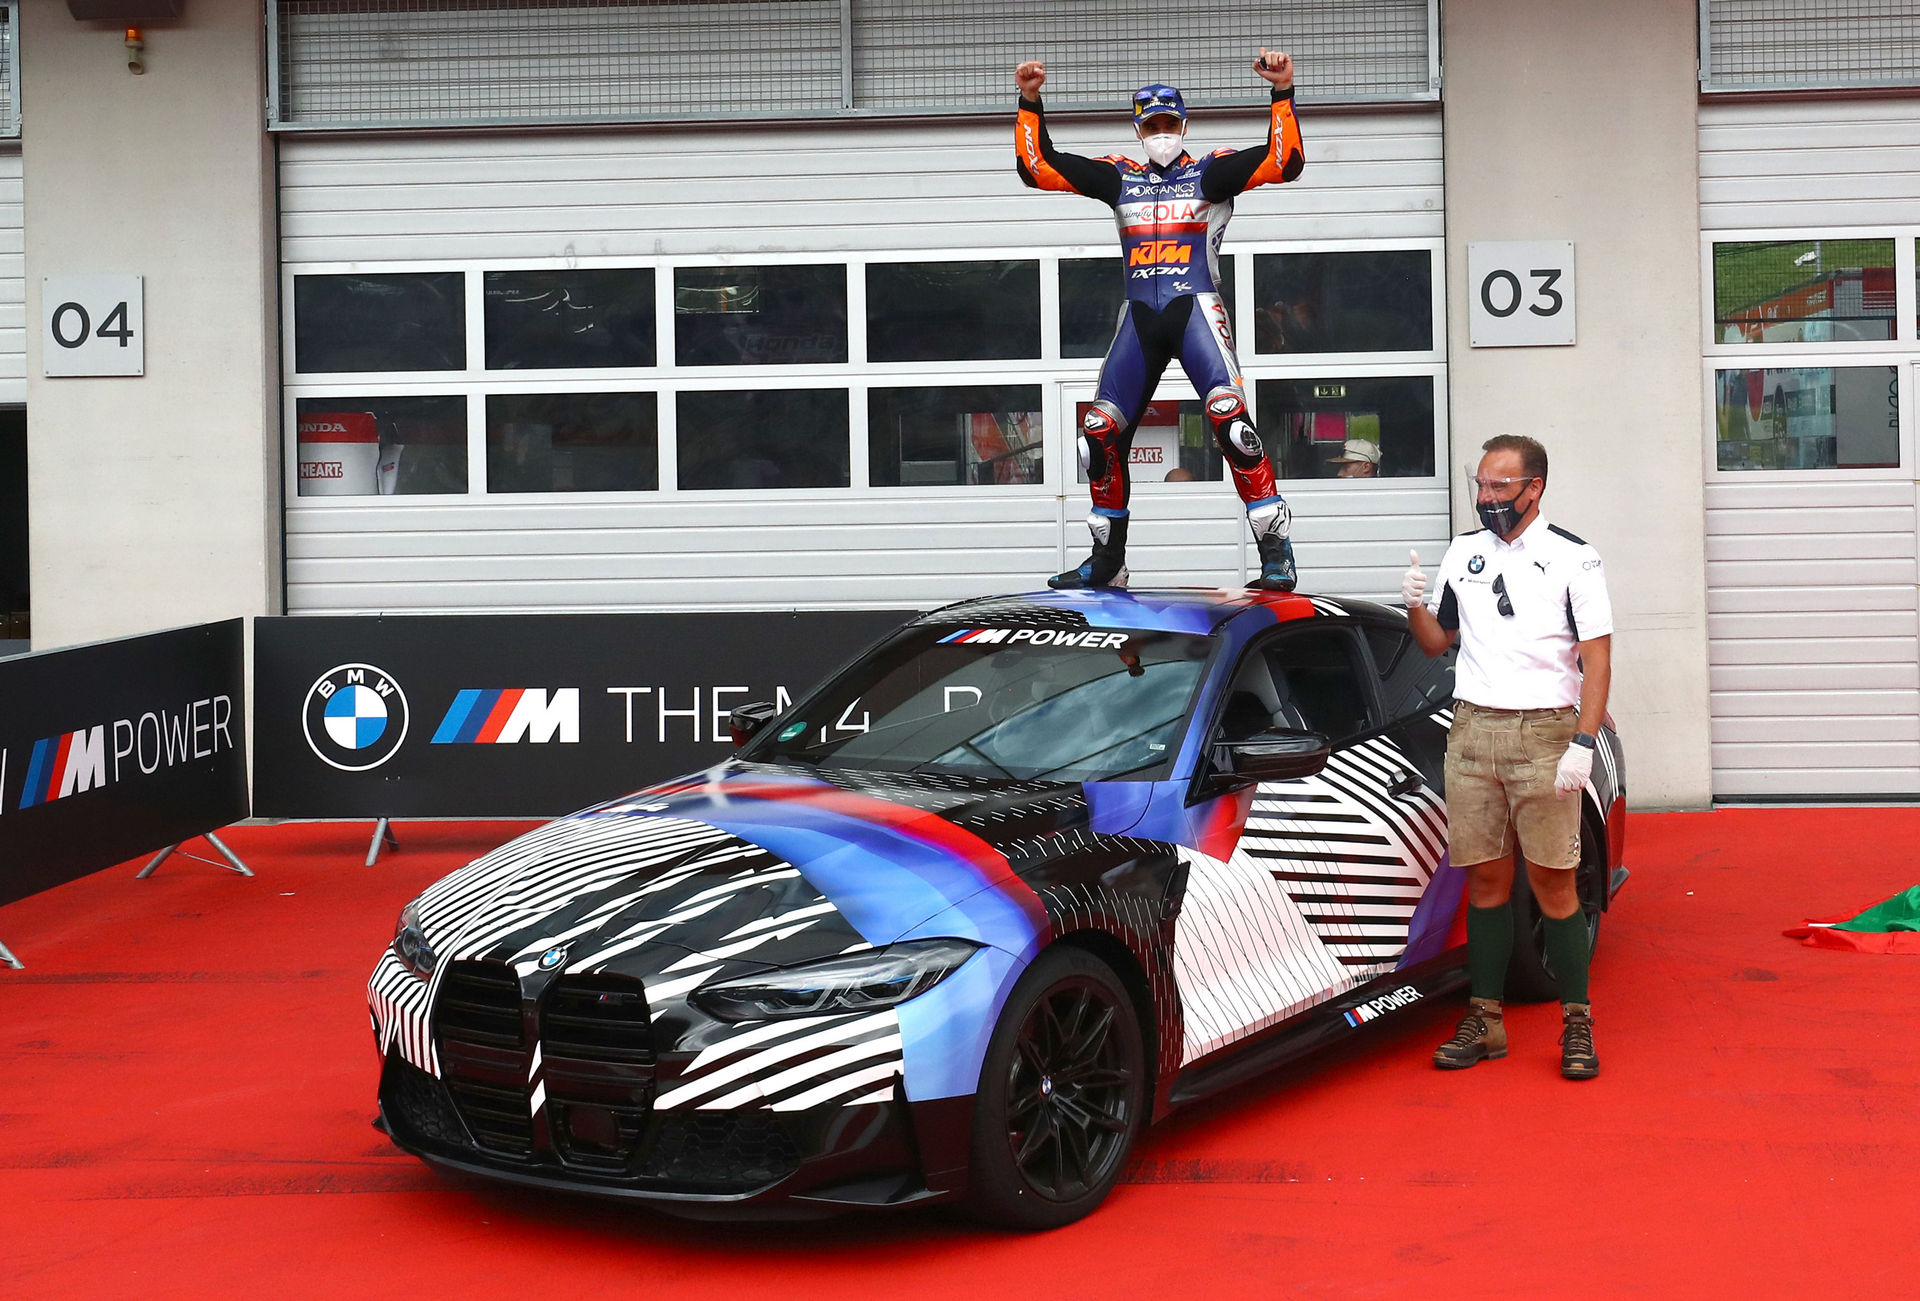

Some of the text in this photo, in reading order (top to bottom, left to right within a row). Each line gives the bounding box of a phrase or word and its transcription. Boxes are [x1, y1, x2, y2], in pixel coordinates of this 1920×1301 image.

[1136, 182, 1195, 197] ORGANICS
[1141, 202, 1195, 221] COLA
[1129, 240, 1192, 266] KTM
[1481, 269, 1563, 317] 03
[51, 301, 134, 349] 04
[1007, 629, 1129, 649] POWER
[317, 669, 395, 699] BMW
[607, 686, 749, 742] THE
[113, 695, 233, 782] POWER
[1369, 985, 1424, 1015] POWER
